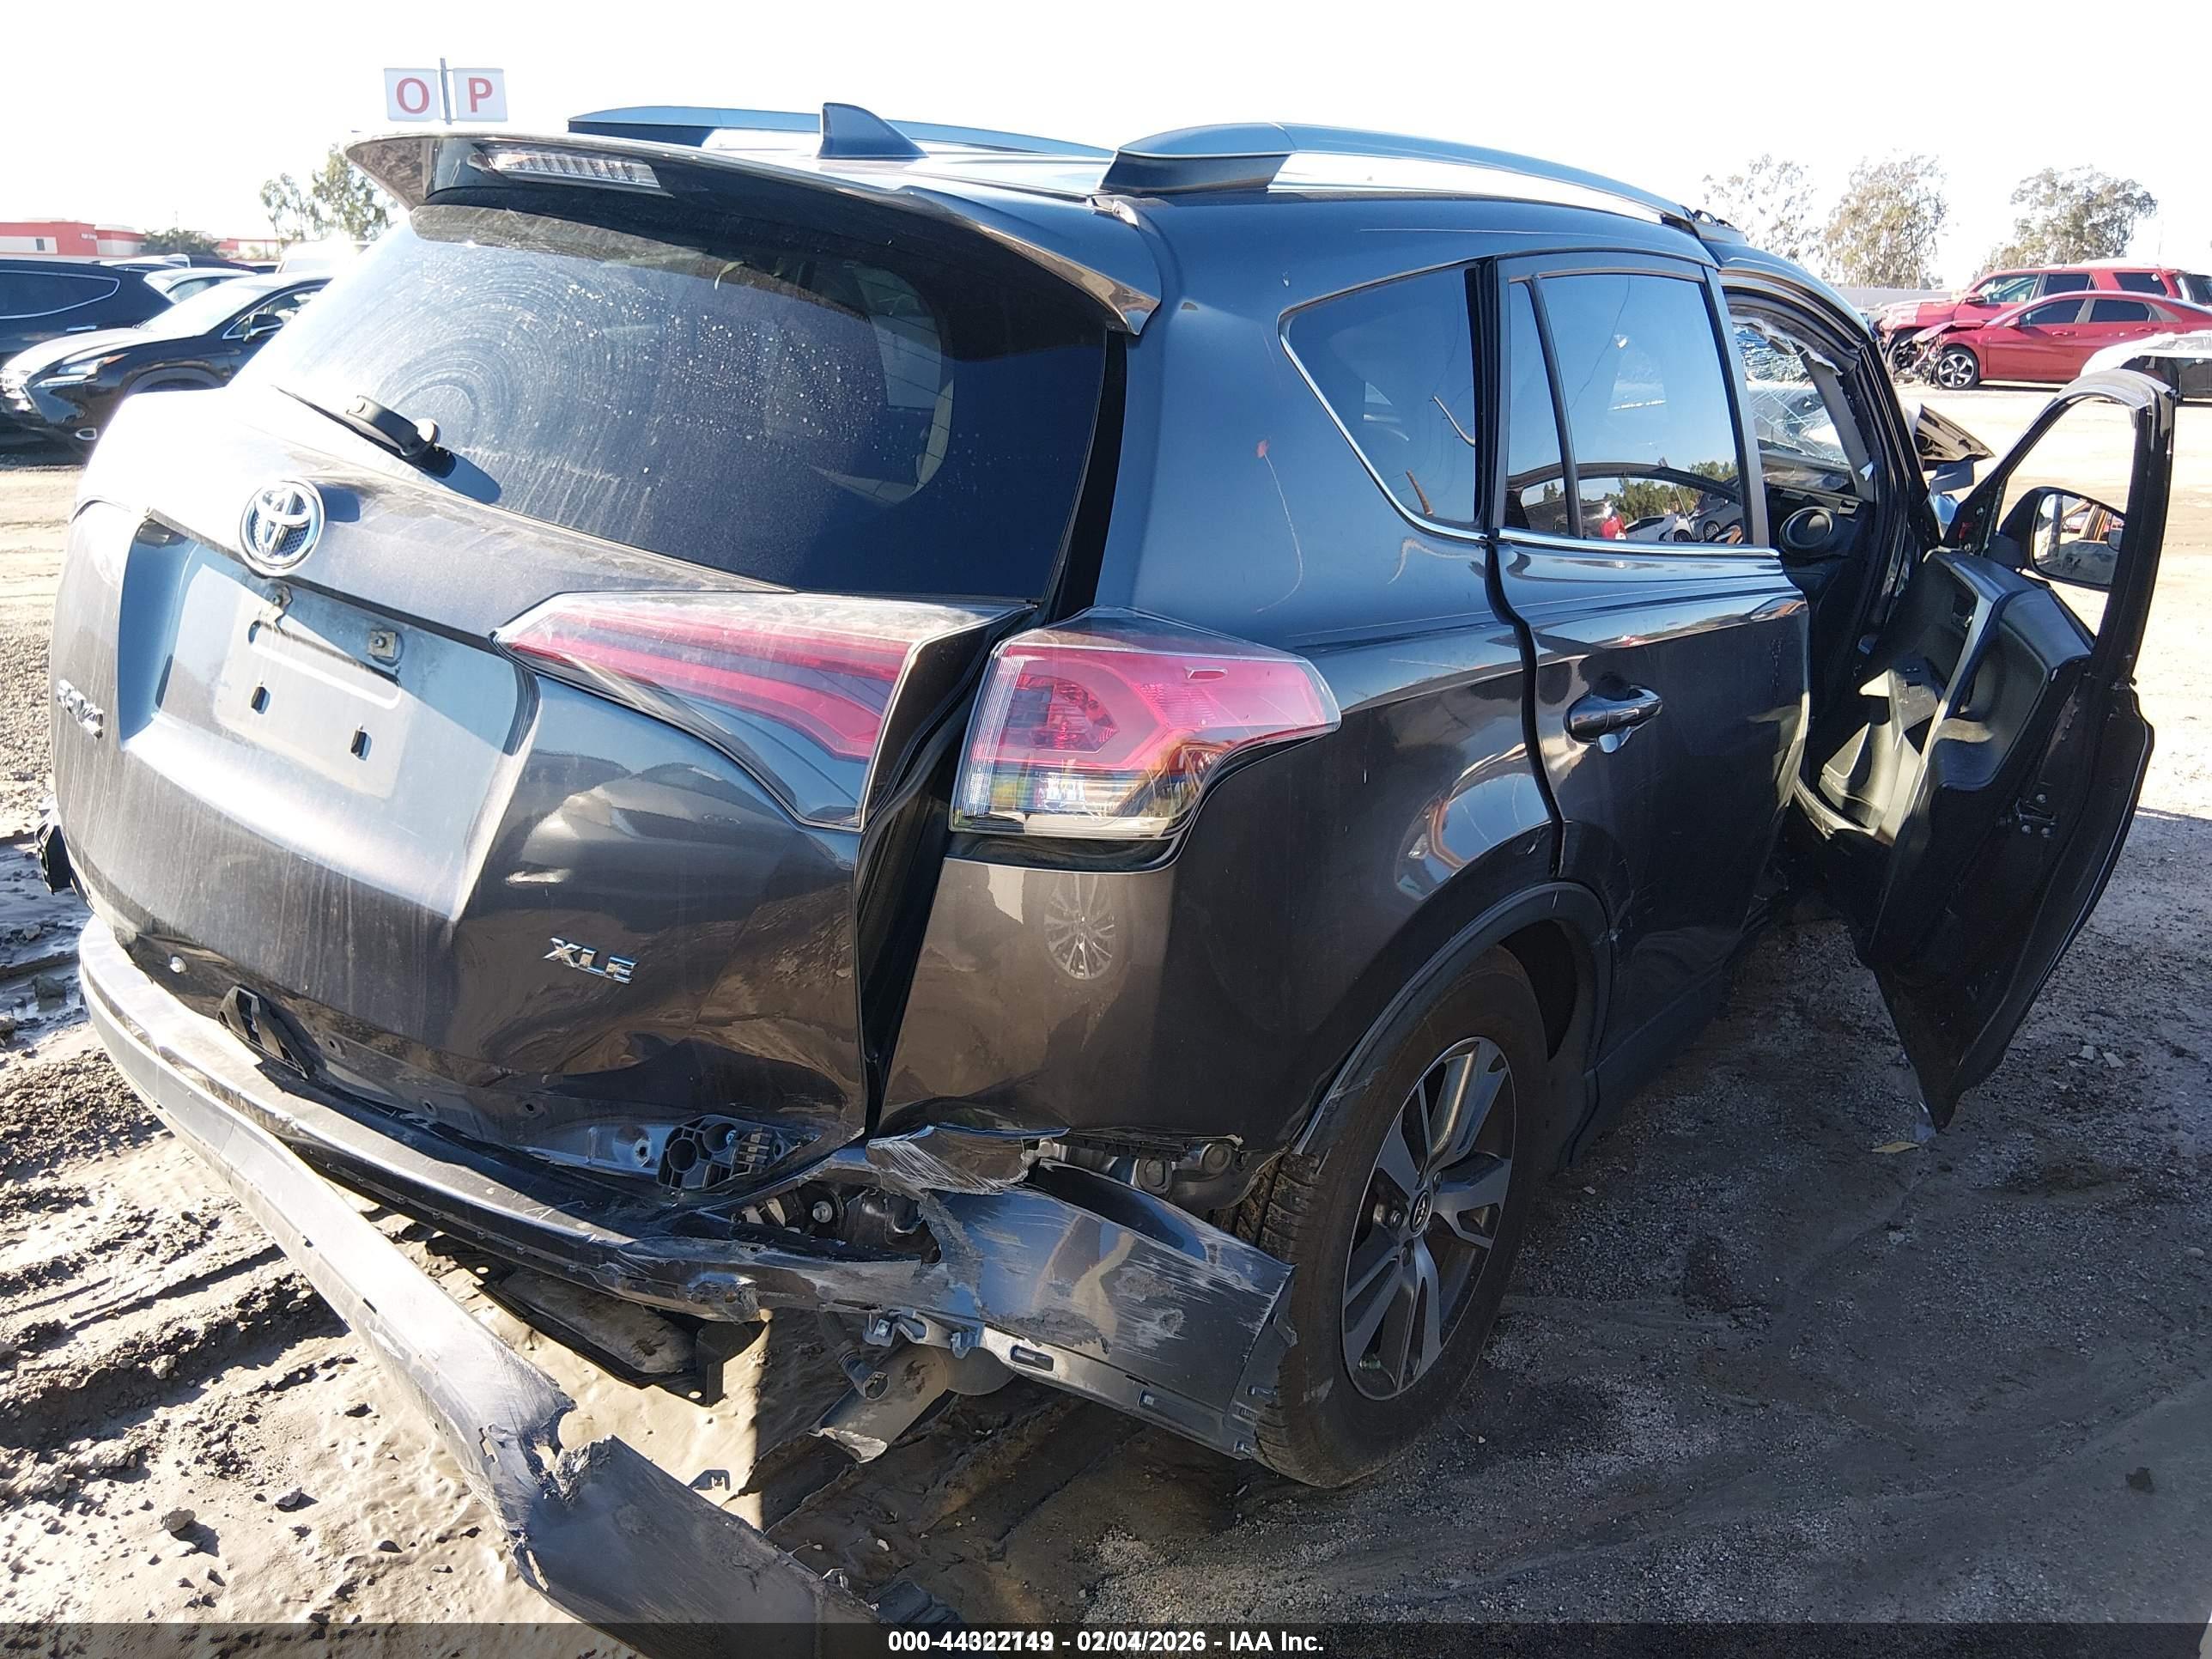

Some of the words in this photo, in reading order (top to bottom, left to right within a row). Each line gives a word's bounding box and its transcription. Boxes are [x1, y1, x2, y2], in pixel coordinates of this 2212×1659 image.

[397, 77, 429, 114] O
[468, 77, 493, 112] P
[543, 936, 638, 985] XLE
